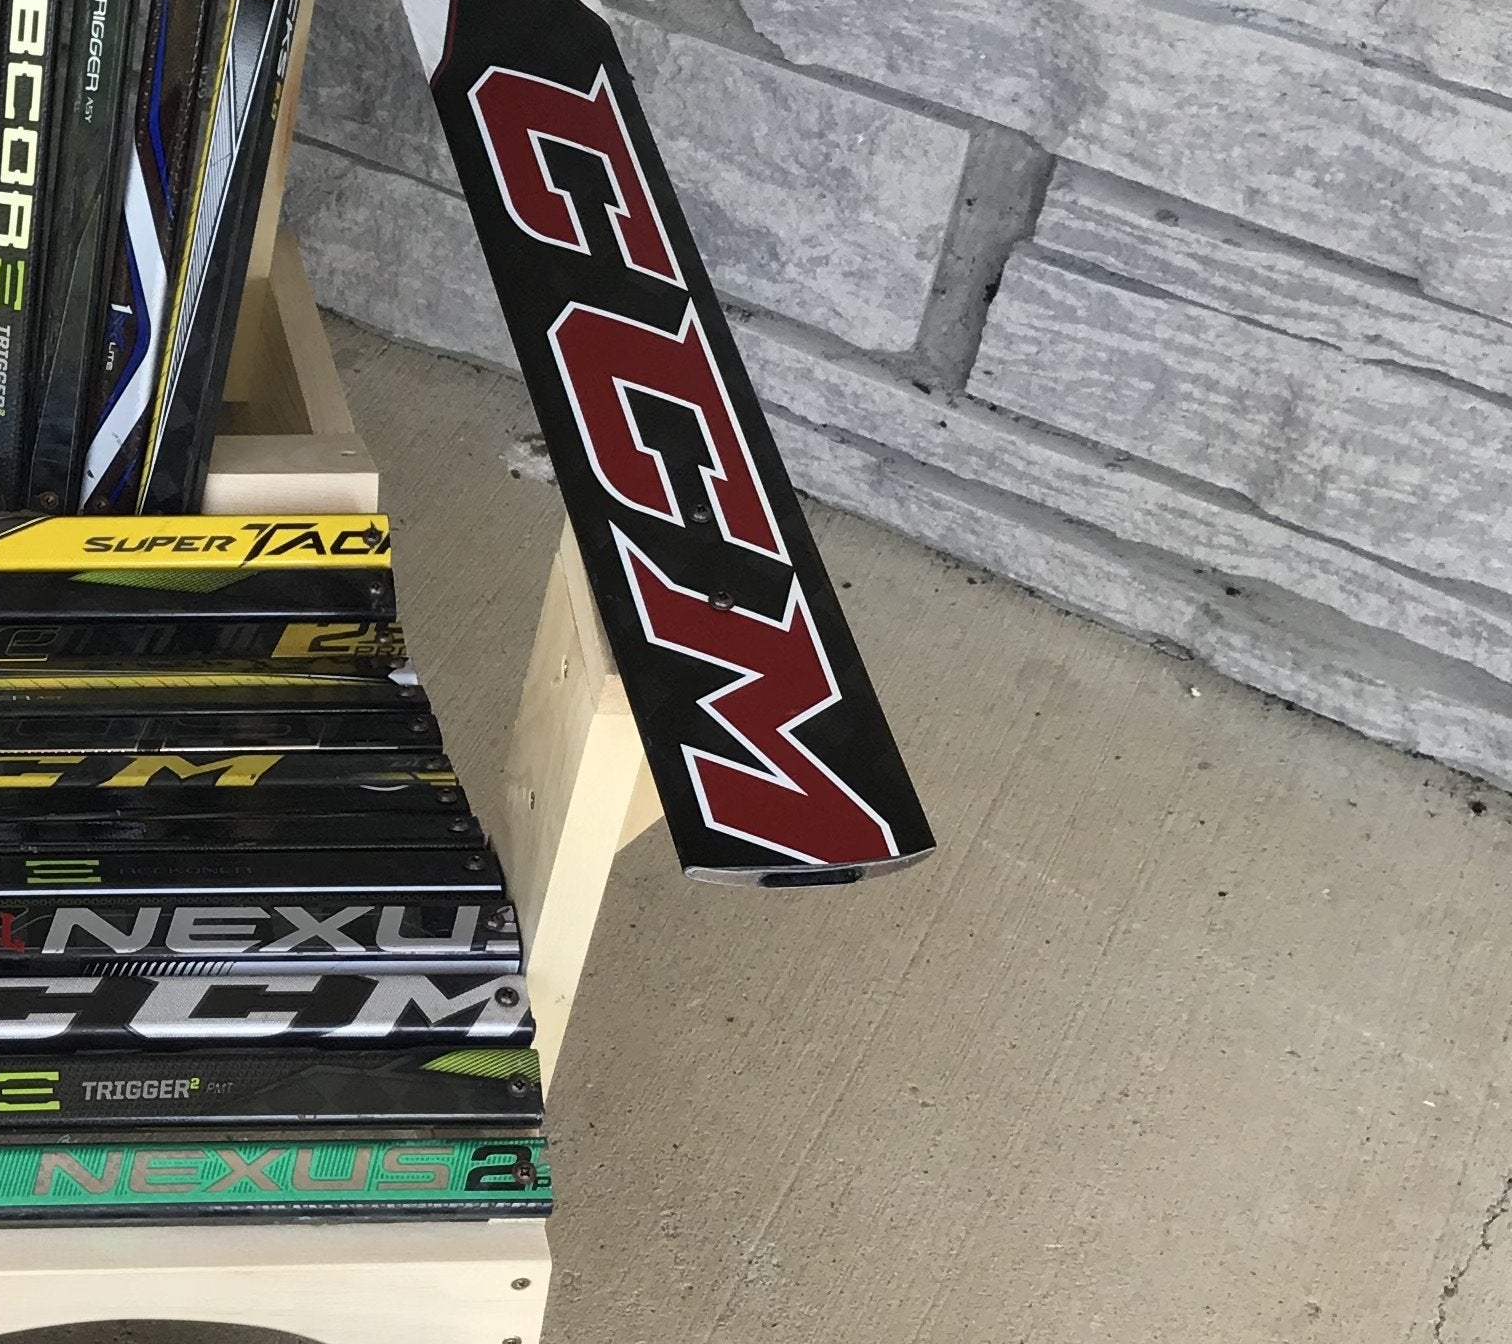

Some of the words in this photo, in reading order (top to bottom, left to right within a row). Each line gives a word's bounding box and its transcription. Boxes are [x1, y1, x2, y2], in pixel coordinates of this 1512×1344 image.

[467, 62, 902, 865] CCM
[81, 534, 237, 554] SUPER
[205, 1081, 234, 1096] PMT
[31, 1147, 457, 1197] NEXUS
